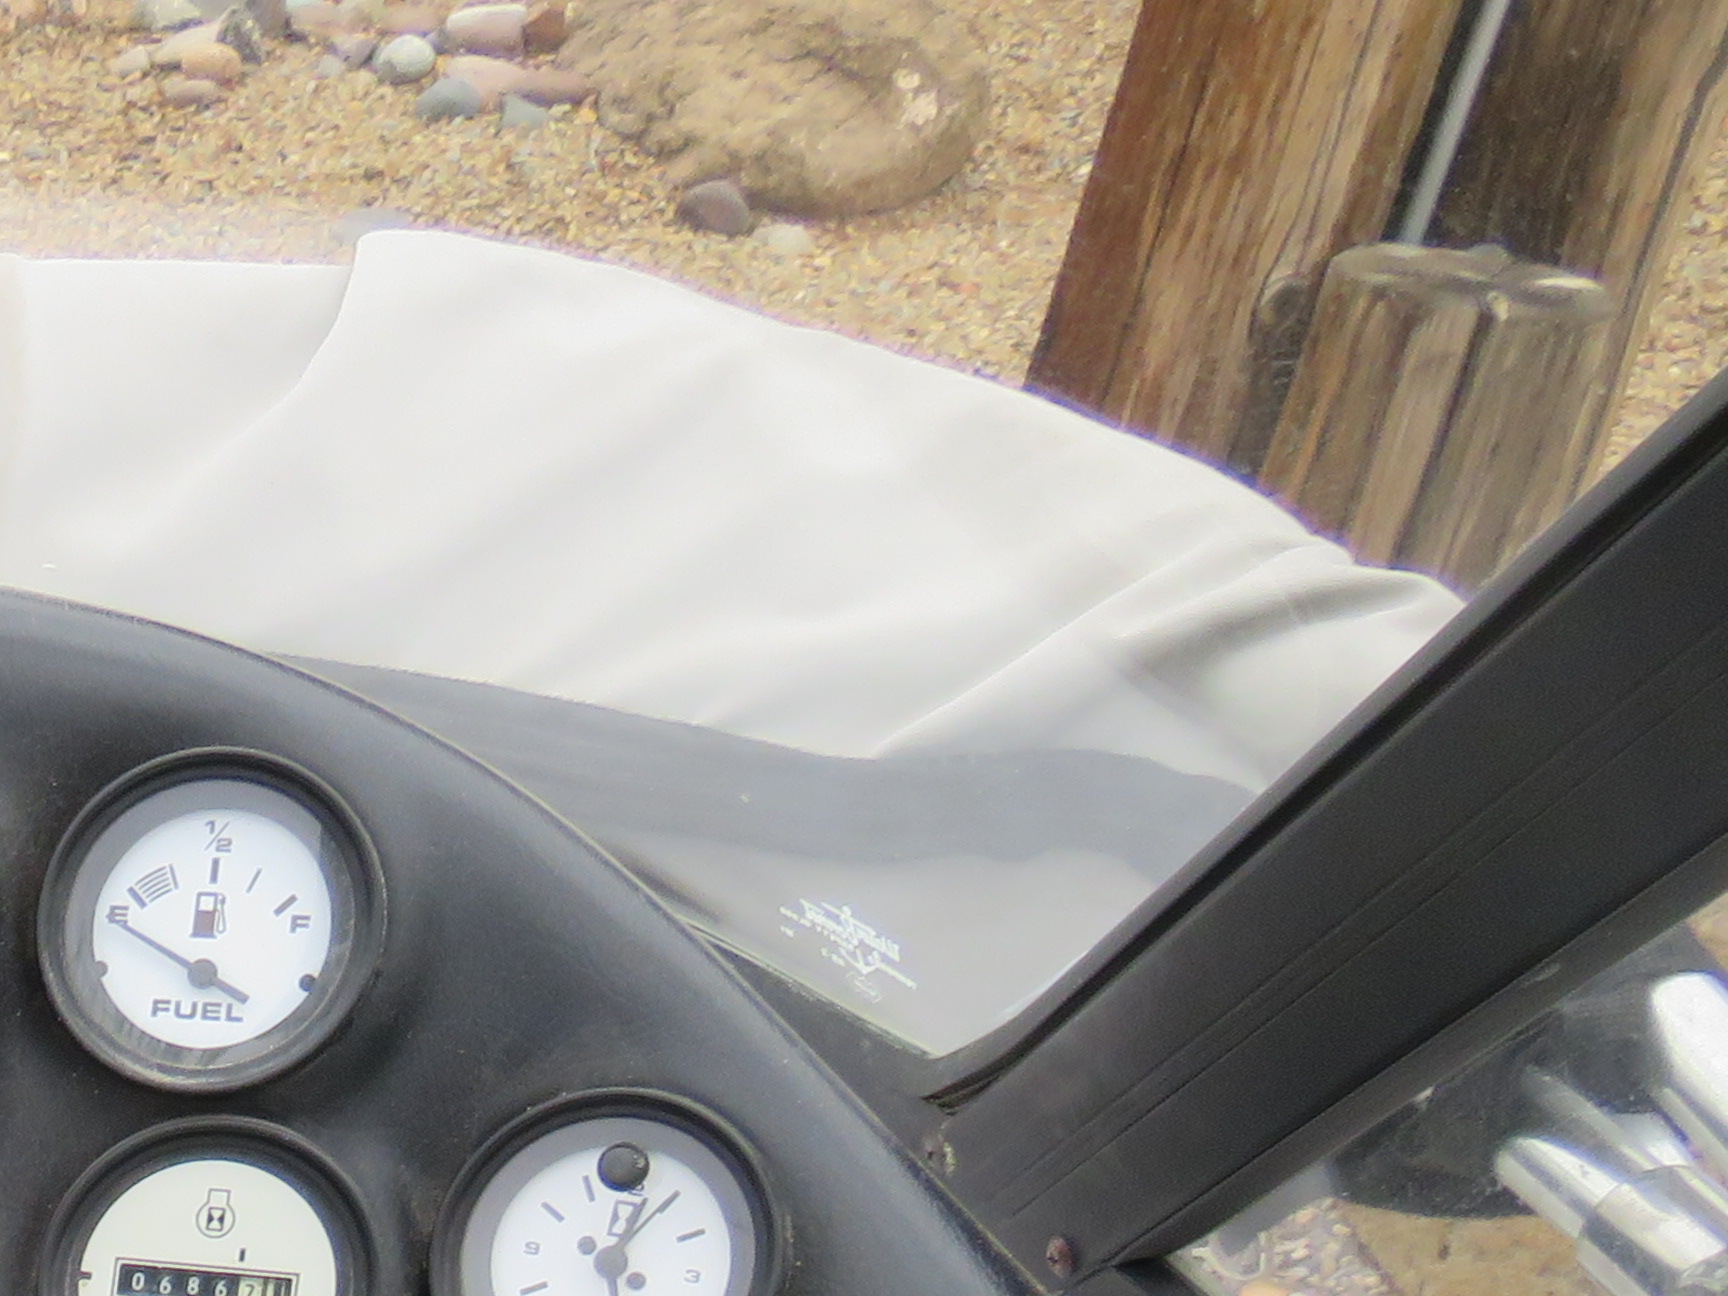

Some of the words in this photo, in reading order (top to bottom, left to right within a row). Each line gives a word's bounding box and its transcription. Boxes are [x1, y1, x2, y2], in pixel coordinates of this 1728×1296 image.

[106, 906, 130, 926] E
[290, 914, 312, 933] F
[150, 998, 244, 1024] FUEL
[524, 1242, 541, 1257] 9
[684, 1269, 701, 1284] 3
